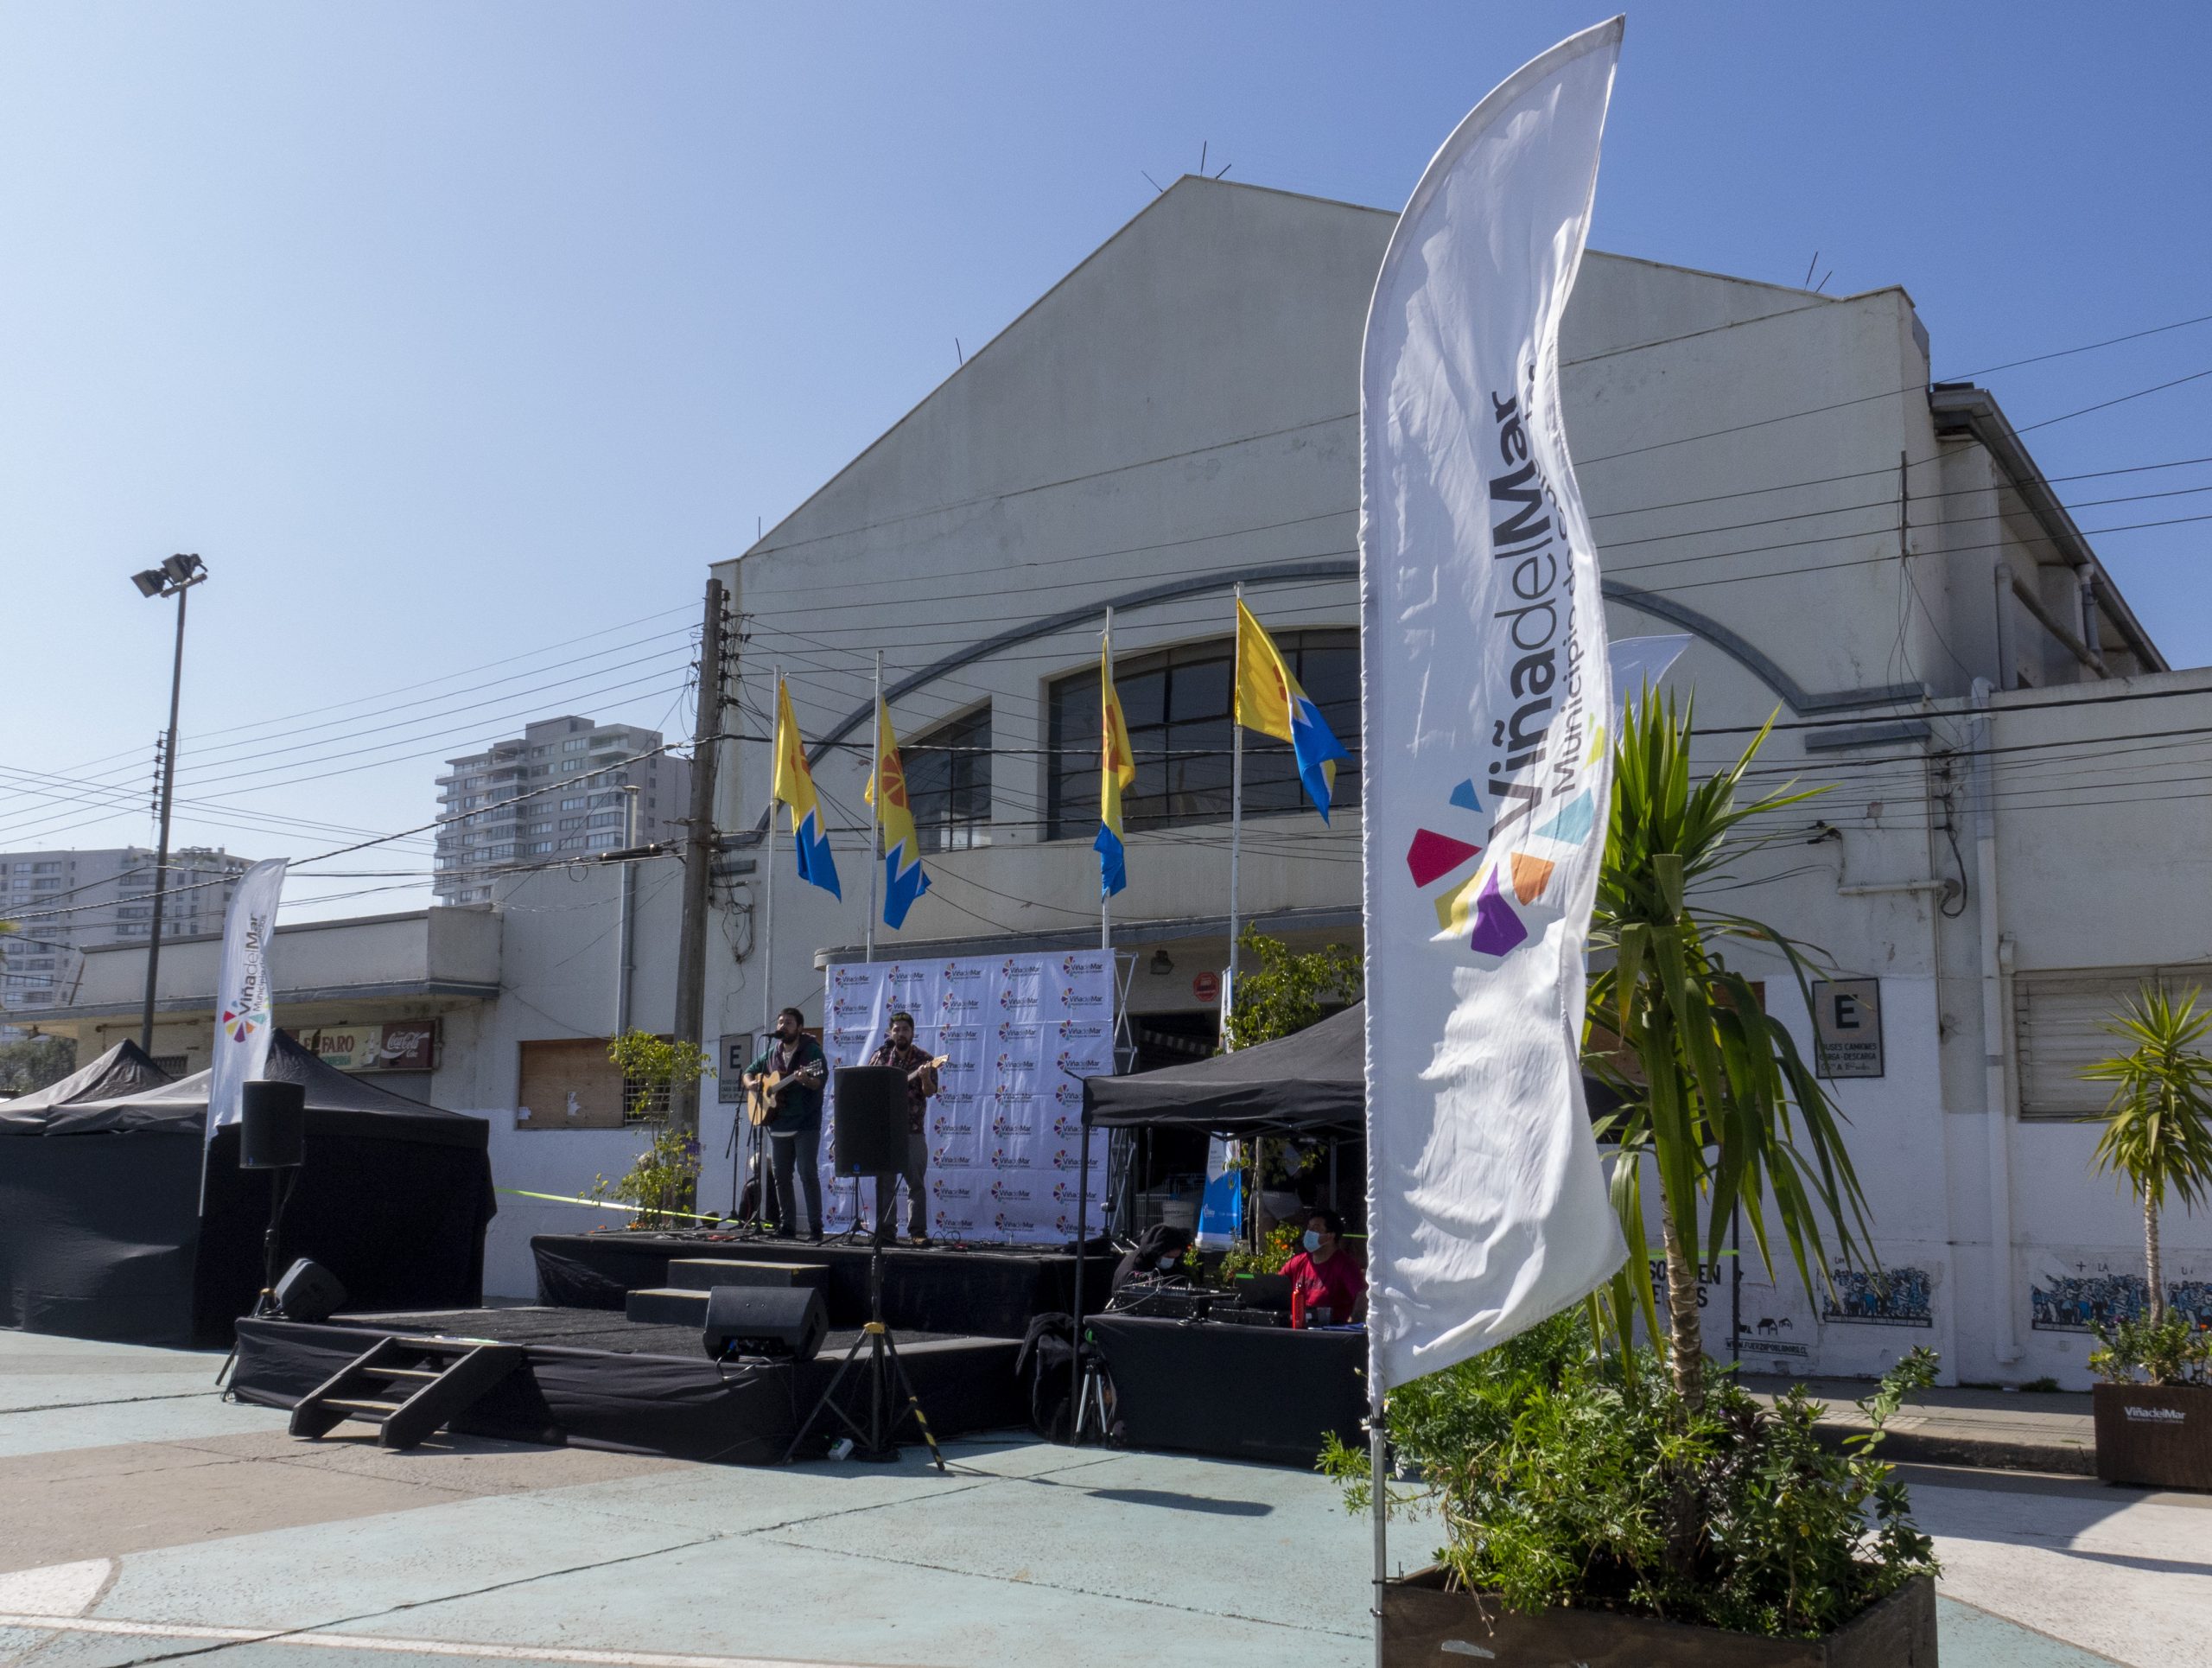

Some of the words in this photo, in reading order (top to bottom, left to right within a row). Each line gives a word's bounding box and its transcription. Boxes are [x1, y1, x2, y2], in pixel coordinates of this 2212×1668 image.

[1488, 391, 1556, 844] ViñadelMar
[238, 913, 259, 1015] ViñadelMar
[1834, 994, 1859, 1029] E
[321, 1035, 355, 1054] FARO
[1844, 1042, 1877, 1051] CAMIONES
[730, 1045, 741, 1069] E
[2124, 1406, 2186, 1419] ViñadelMar
